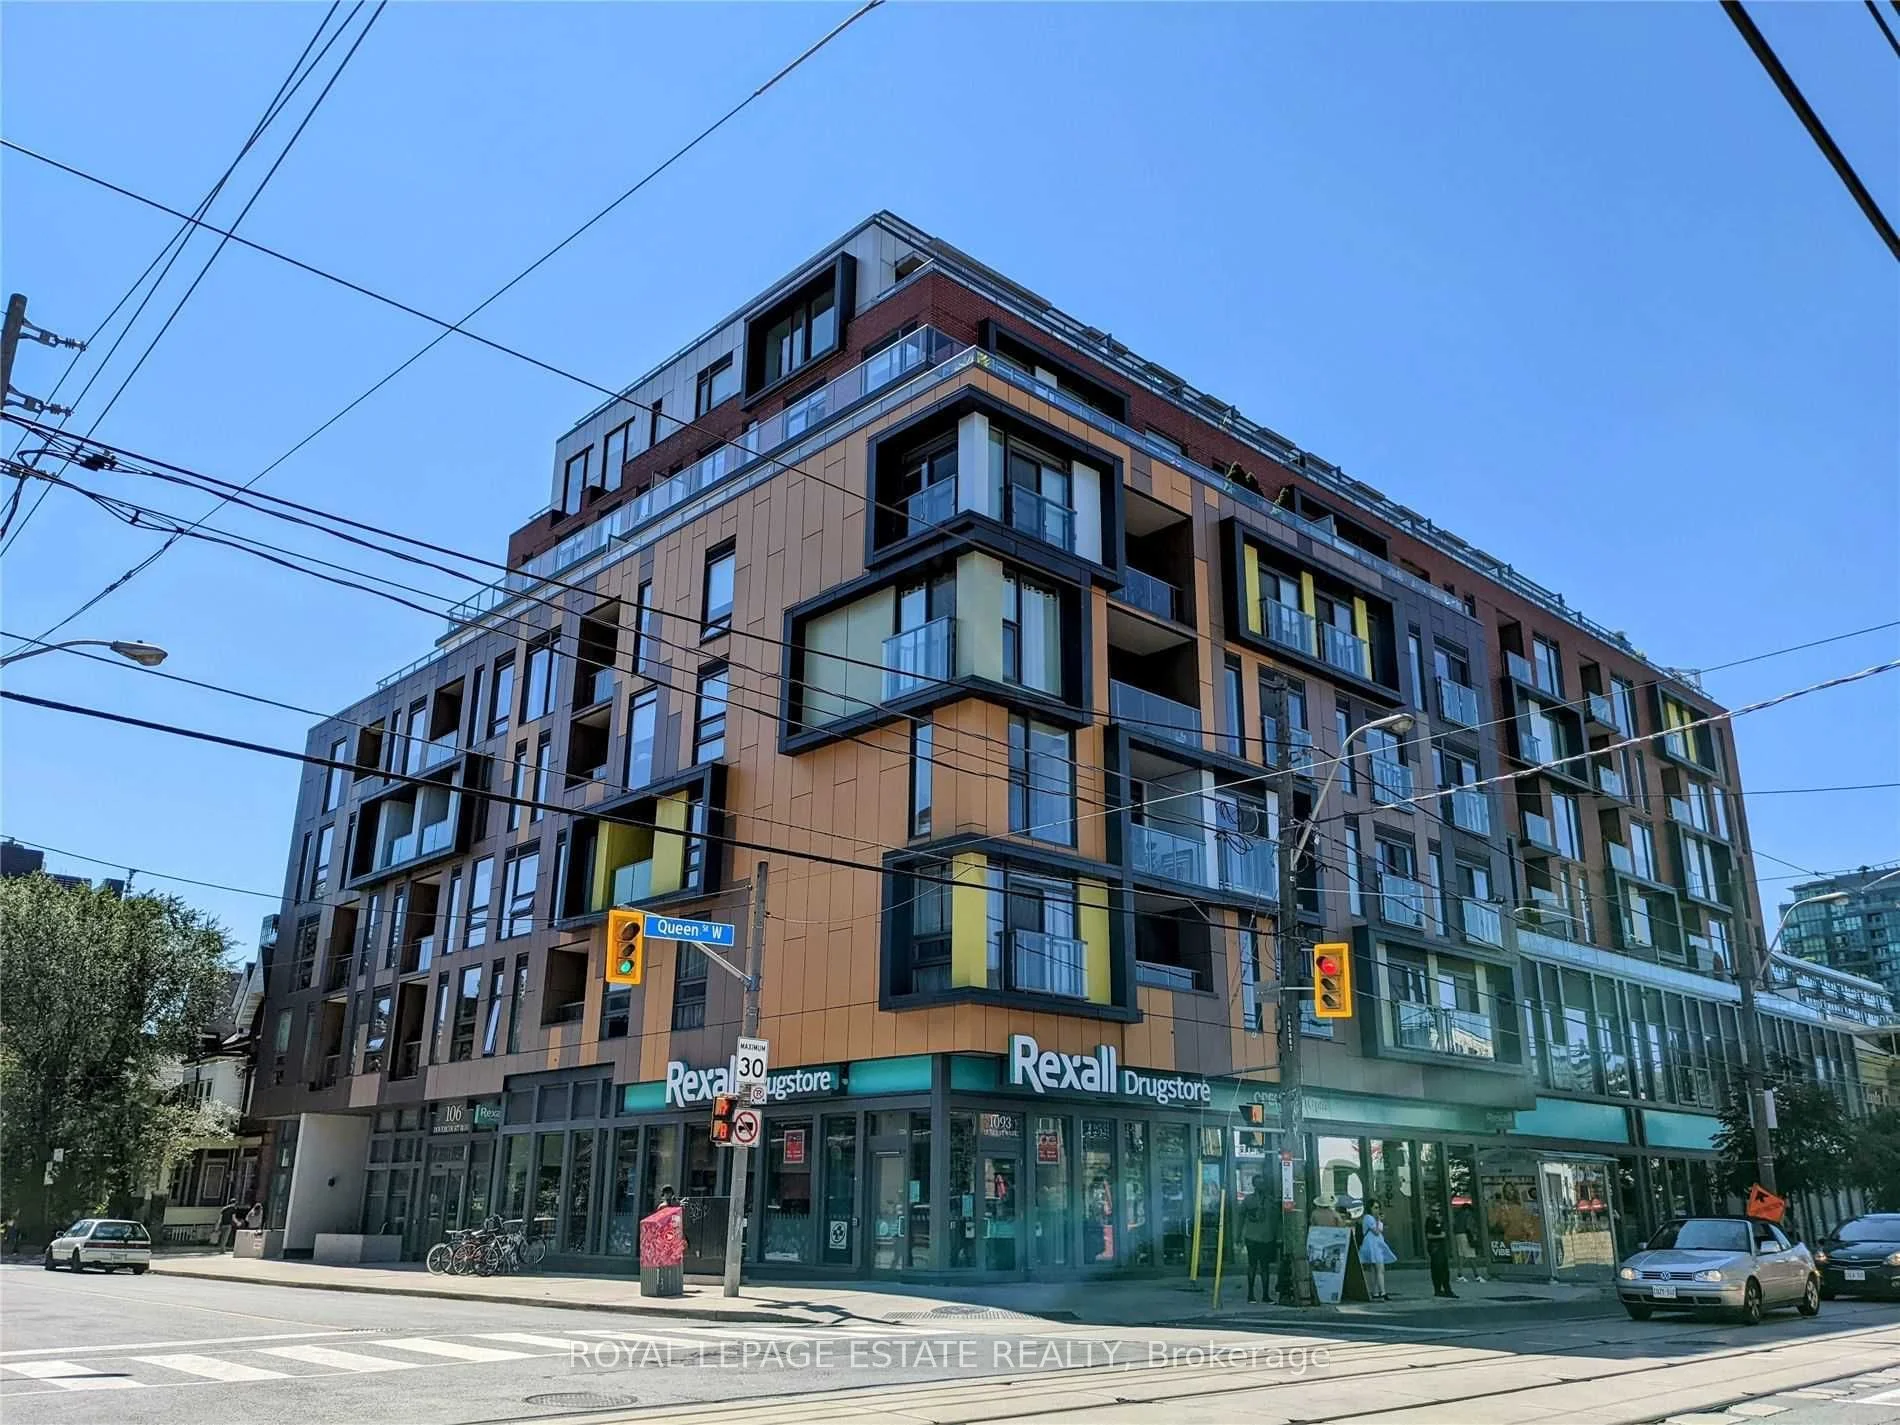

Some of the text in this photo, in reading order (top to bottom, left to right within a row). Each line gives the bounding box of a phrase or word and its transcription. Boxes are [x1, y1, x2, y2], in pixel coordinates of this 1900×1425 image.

[657, 919, 699, 937] Queen
[711, 925, 723, 939] W
[739, 1042, 767, 1052] MAXIMUM
[738, 1056, 764, 1078] 30
[1010, 1033, 1211, 1104] Rexall Drugstore
[445, 1104, 462, 1122] 106
[1492, 1248, 1511, 1257] VIBE
